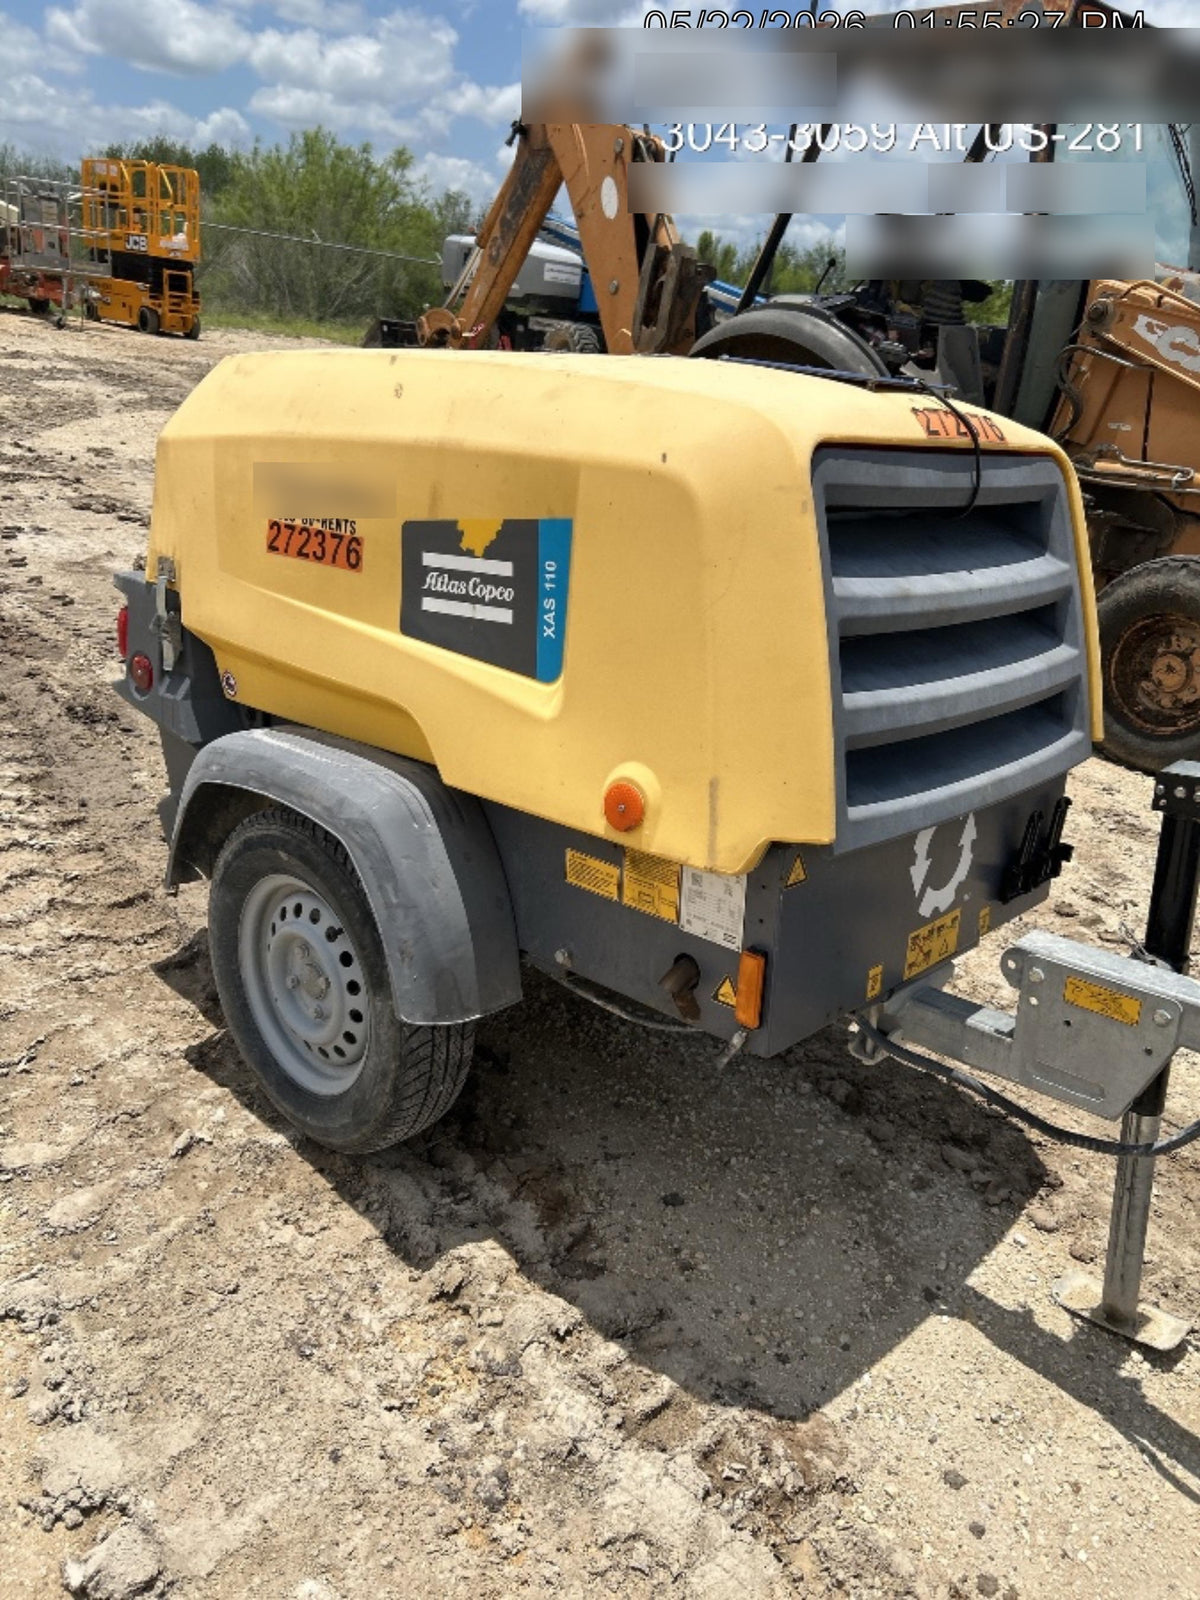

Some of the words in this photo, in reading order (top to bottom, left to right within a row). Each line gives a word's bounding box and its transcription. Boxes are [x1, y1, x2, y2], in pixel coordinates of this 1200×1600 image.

[125, 235, 148, 252] JCB
[911, 407, 1005, 442] 27276
[267, 520, 362, 570] 272376
[421, 571, 467, 595] Atlas
[468, 577, 515, 602] Copco
[544, 560, 558, 591] 110
[543, 598, 556, 639] XAS
